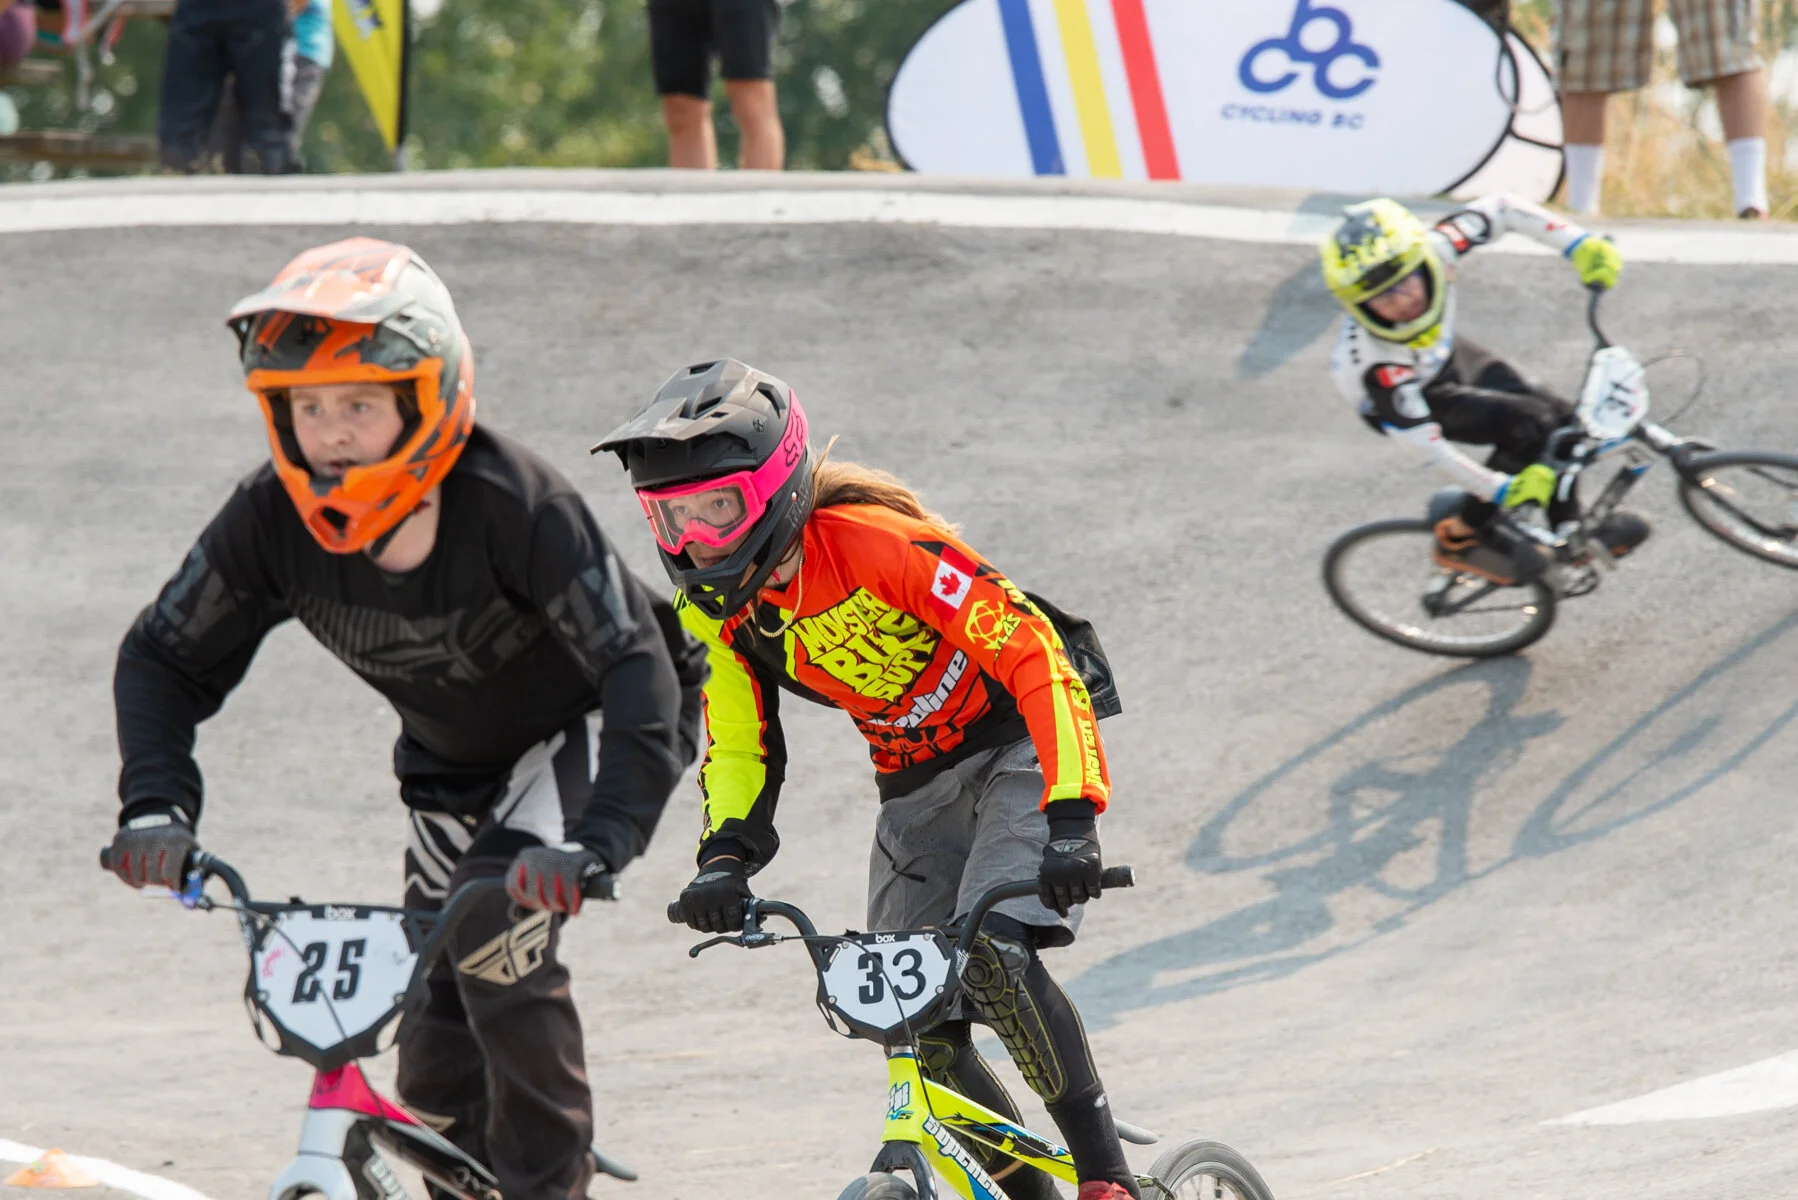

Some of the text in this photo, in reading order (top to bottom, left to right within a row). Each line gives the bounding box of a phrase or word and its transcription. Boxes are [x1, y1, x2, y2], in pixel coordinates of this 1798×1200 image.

[1220, 104, 1365, 130] CYCLING BC
[875, 933, 896, 944] box
[292, 939, 366, 1004] 25
[857, 948, 927, 1005] 33
